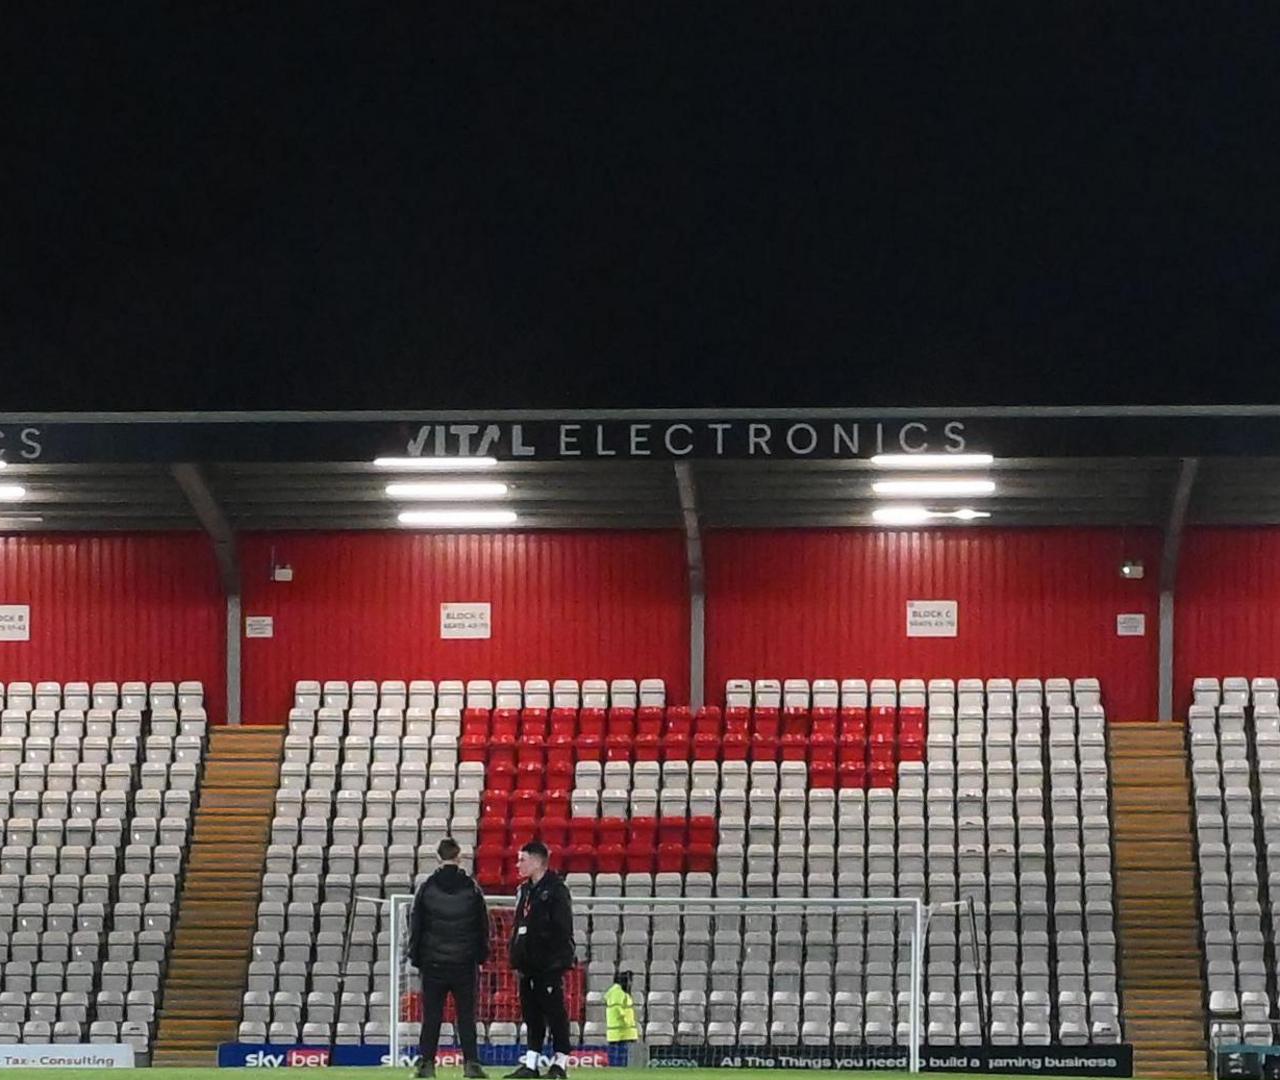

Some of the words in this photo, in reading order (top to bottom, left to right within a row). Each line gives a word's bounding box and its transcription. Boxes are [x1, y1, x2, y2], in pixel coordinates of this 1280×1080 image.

[559, 422, 966, 455] ELECTRONICS
[446, 612, 476, 620] BLOCK
[912, 610, 943, 618] BLOCK
[5, 1056, 26, 1065] Tax
[40, 1056, 114, 1066] Consulting
[245, 1051, 284, 1067] sky
[291, 1051, 329, 1067] bet
[721, 1056, 742, 1067] All
[744, 1057, 775, 1067] The
[778, 1057, 831, 1069] Things
[835, 1059, 862, 1070] you
[867, 1056, 906, 1067] need
[930, 1056, 968, 1068] build
[970, 1058, 980, 1068] a
[1045, 1056, 1117, 1068] business
